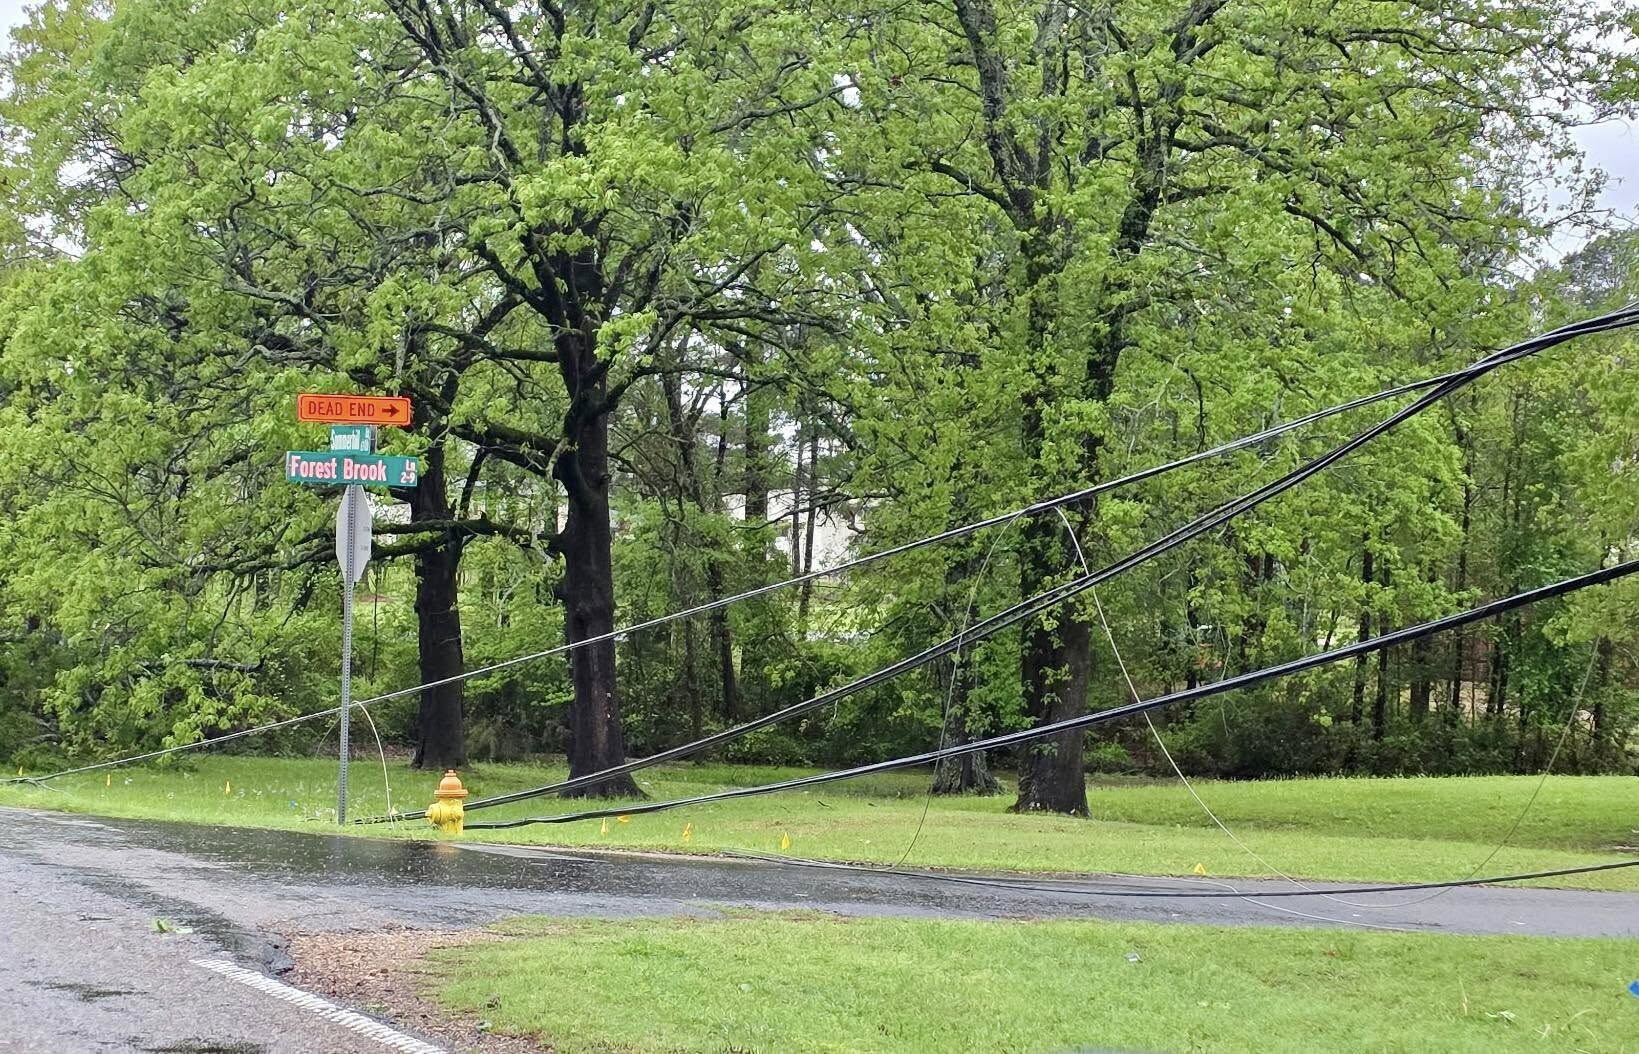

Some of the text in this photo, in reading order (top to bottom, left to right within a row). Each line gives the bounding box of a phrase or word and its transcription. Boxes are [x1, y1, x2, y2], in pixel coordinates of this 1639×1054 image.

[308, 401, 375, 417] DEAD END
[290, 455, 416, 482] Forest Brook Ln
